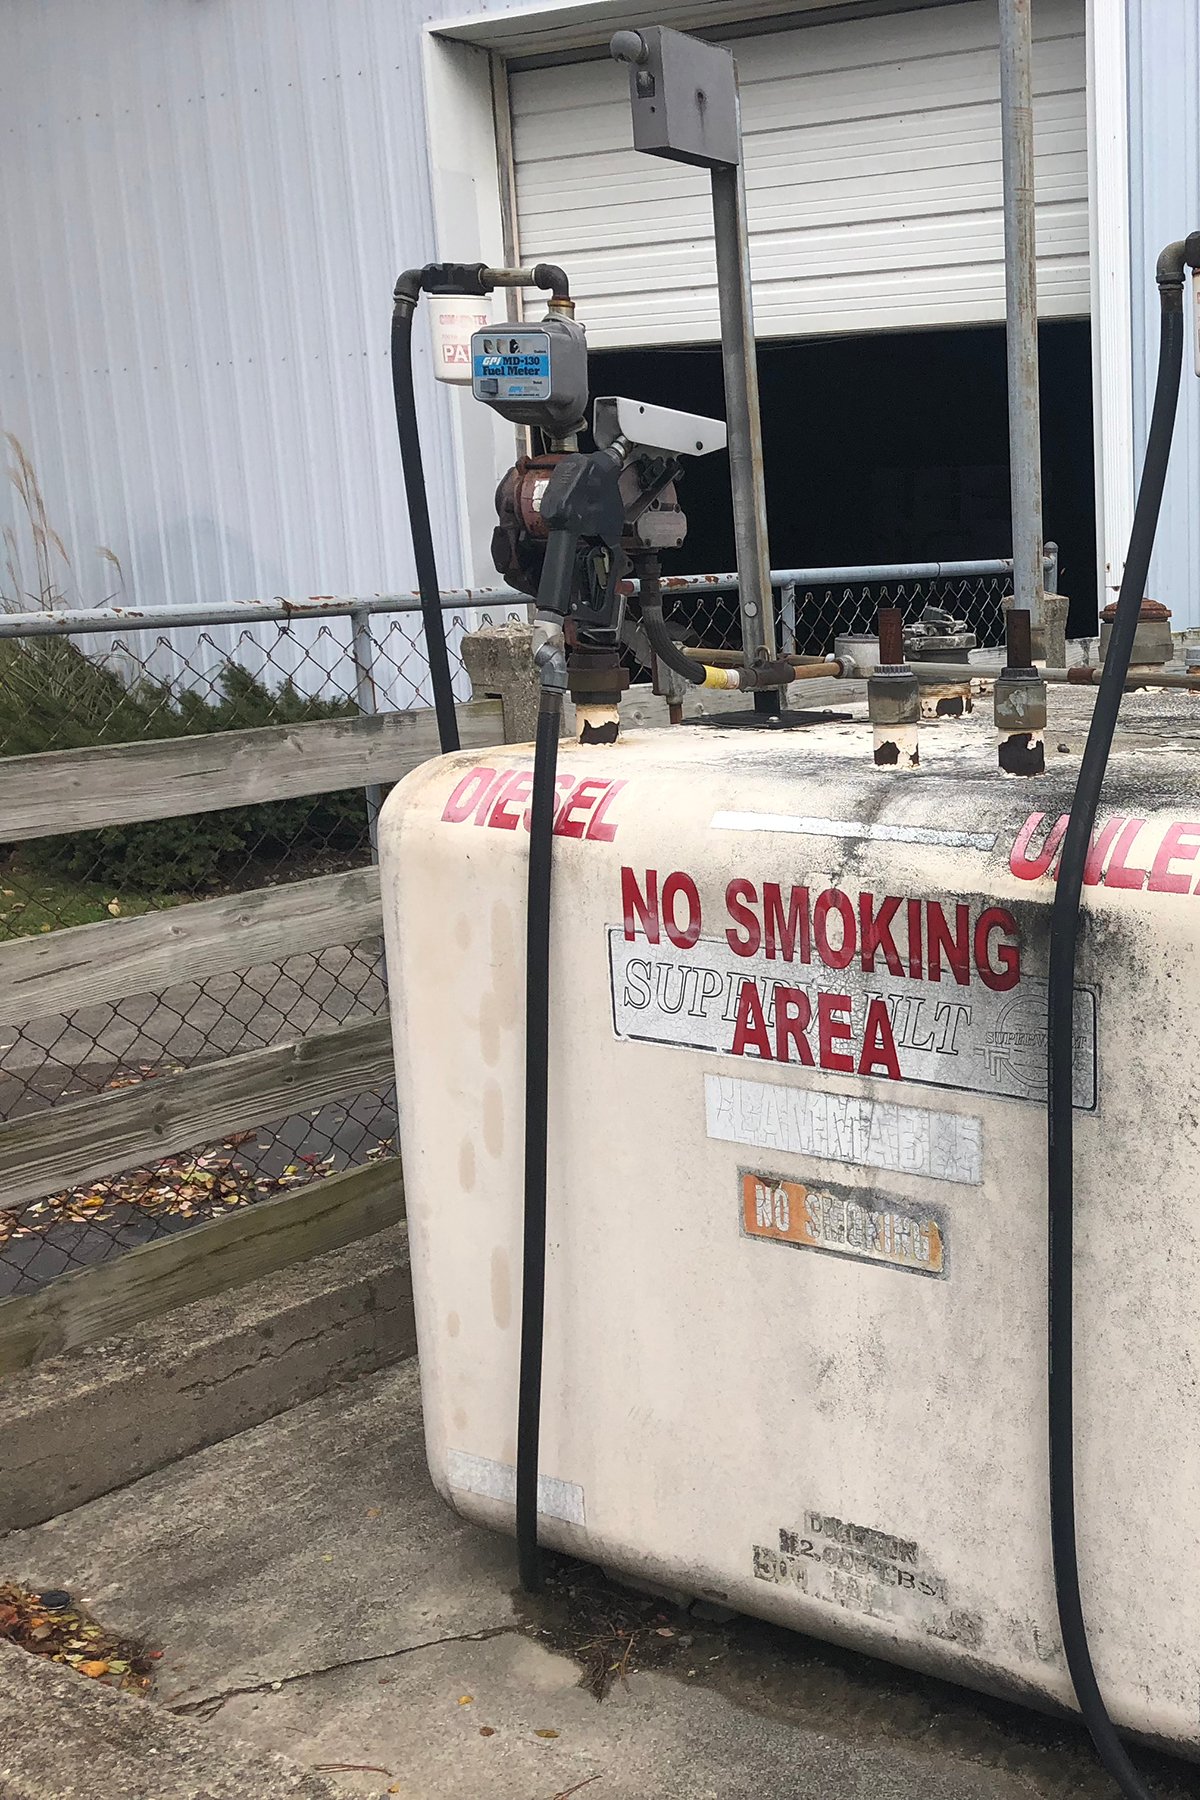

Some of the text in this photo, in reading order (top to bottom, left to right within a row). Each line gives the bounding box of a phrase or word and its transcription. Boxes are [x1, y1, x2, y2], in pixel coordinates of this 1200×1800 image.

[443, 345, 471, 362] PA
[482, 356, 540, 366] GPI MD-130
[483, 366, 540, 376] Fuel Meter
[620, 867, 1021, 992] NO SMOKING
[731, 982, 902, 1080] AREA
[755, 1184, 790, 1232] NO
